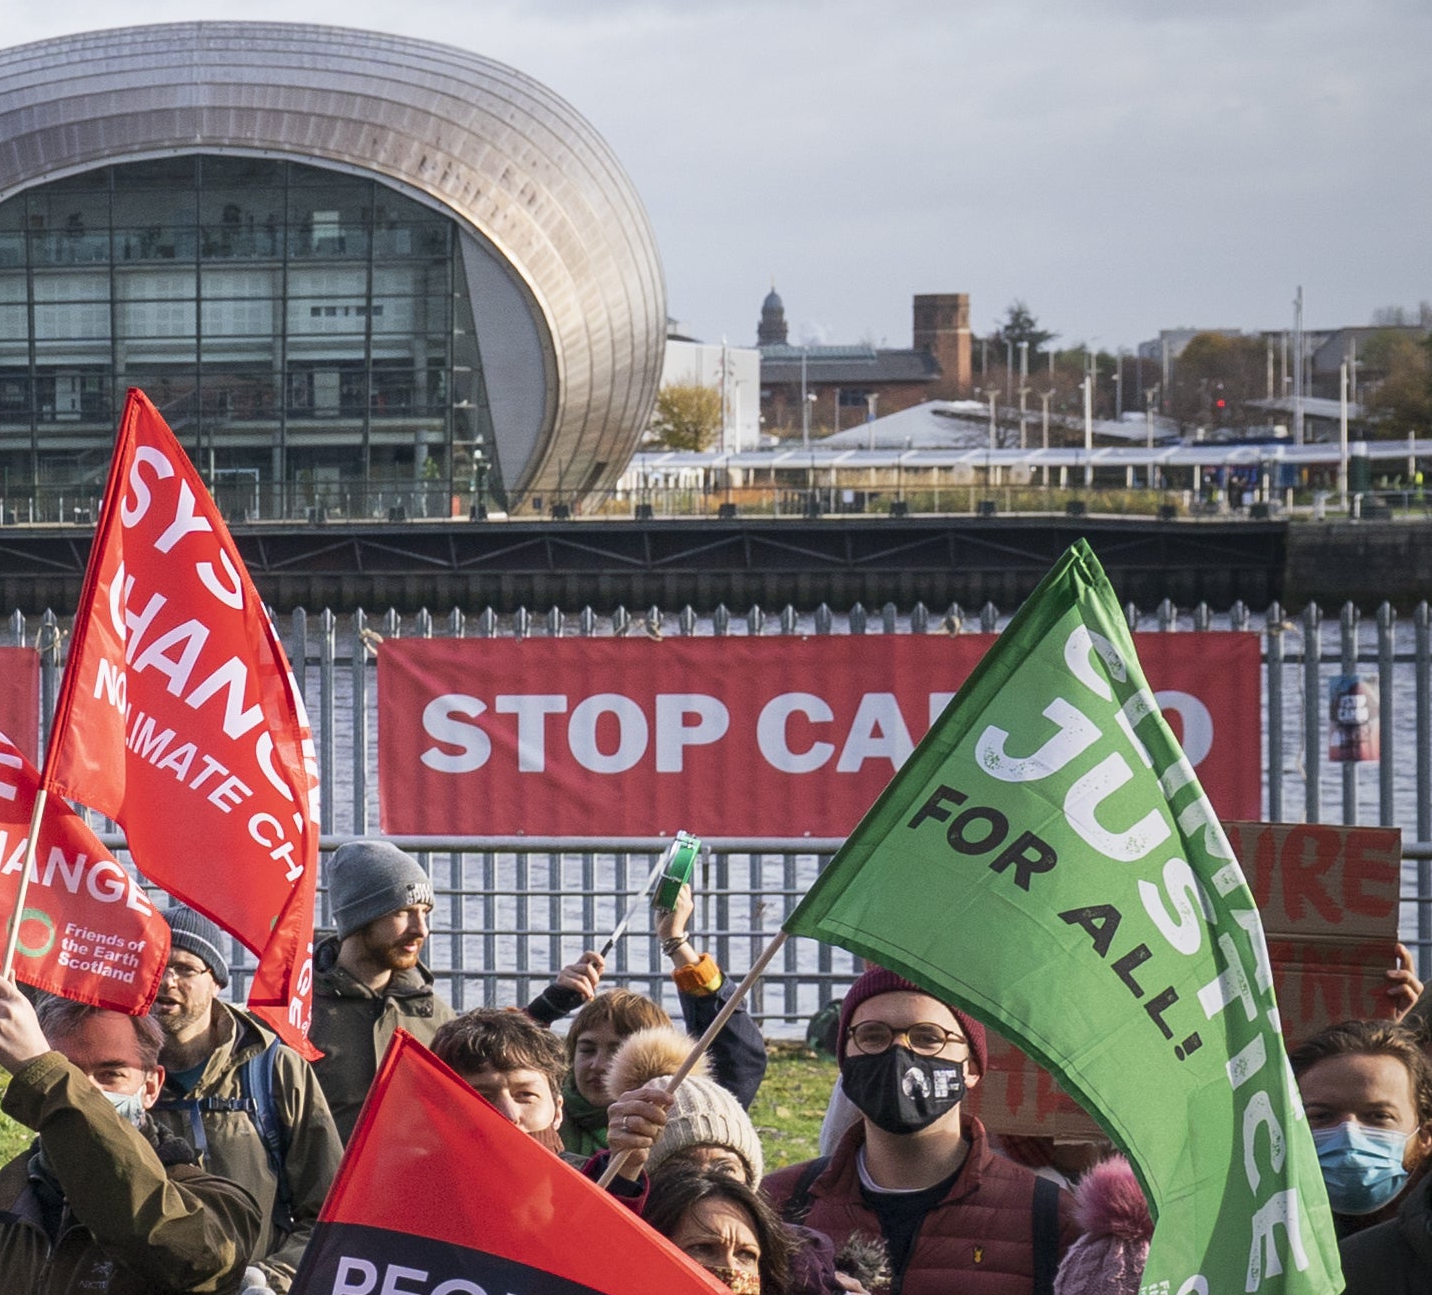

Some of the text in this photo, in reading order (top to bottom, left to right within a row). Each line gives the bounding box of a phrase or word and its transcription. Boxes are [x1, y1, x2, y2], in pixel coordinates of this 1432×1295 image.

[421, 692, 731, 774] STOP
[65, 922, 146, 953] Friends of
[909, 783, 1059, 893] FOR
[1058, 903, 1204, 1063] ALL!
[58, 951, 136, 983] Scotland
[61, 937, 139, 968] the Earth
